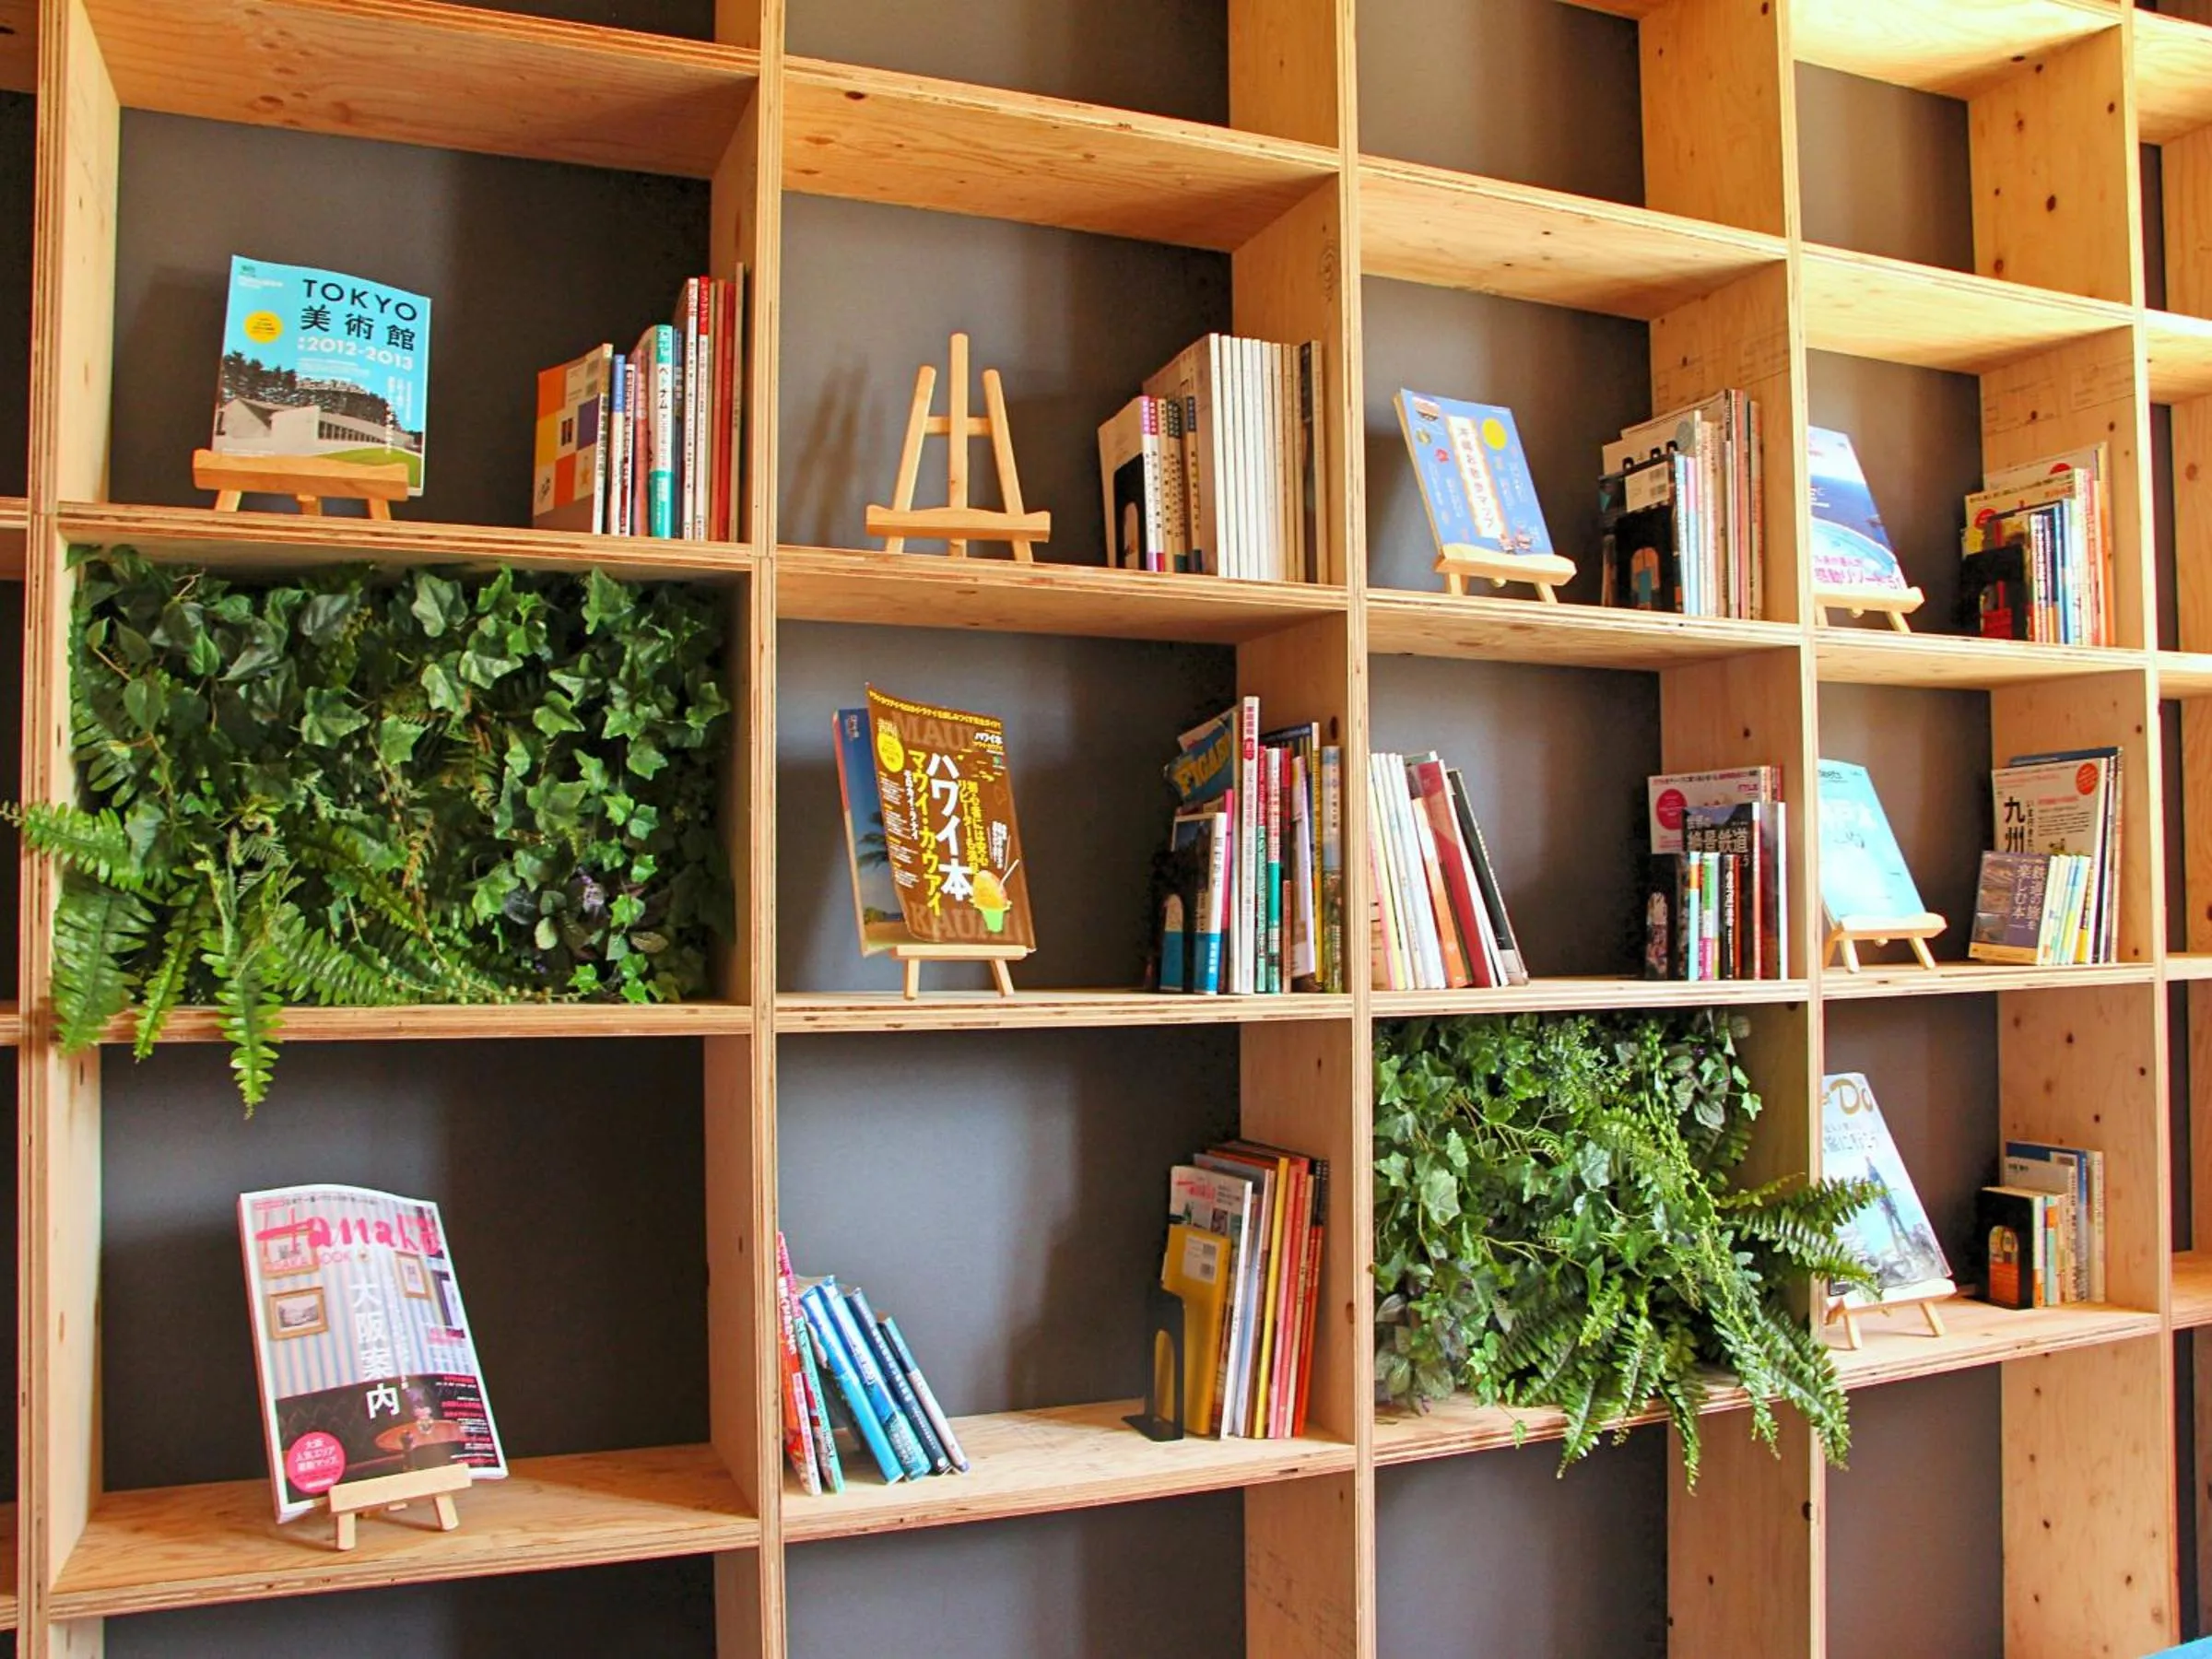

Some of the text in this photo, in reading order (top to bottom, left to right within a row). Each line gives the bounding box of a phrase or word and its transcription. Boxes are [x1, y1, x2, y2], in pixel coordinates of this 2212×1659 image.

[300, 304, 415, 352] 美術館
[301, 278, 418, 322] TOKYO
[908, 749, 942, 916] マウイ・カウアイ
[925, 752, 975, 901] ハワイ本
[2004, 796, 2026, 853] 九州
[349, 1274, 400, 1419] 大阪案内
